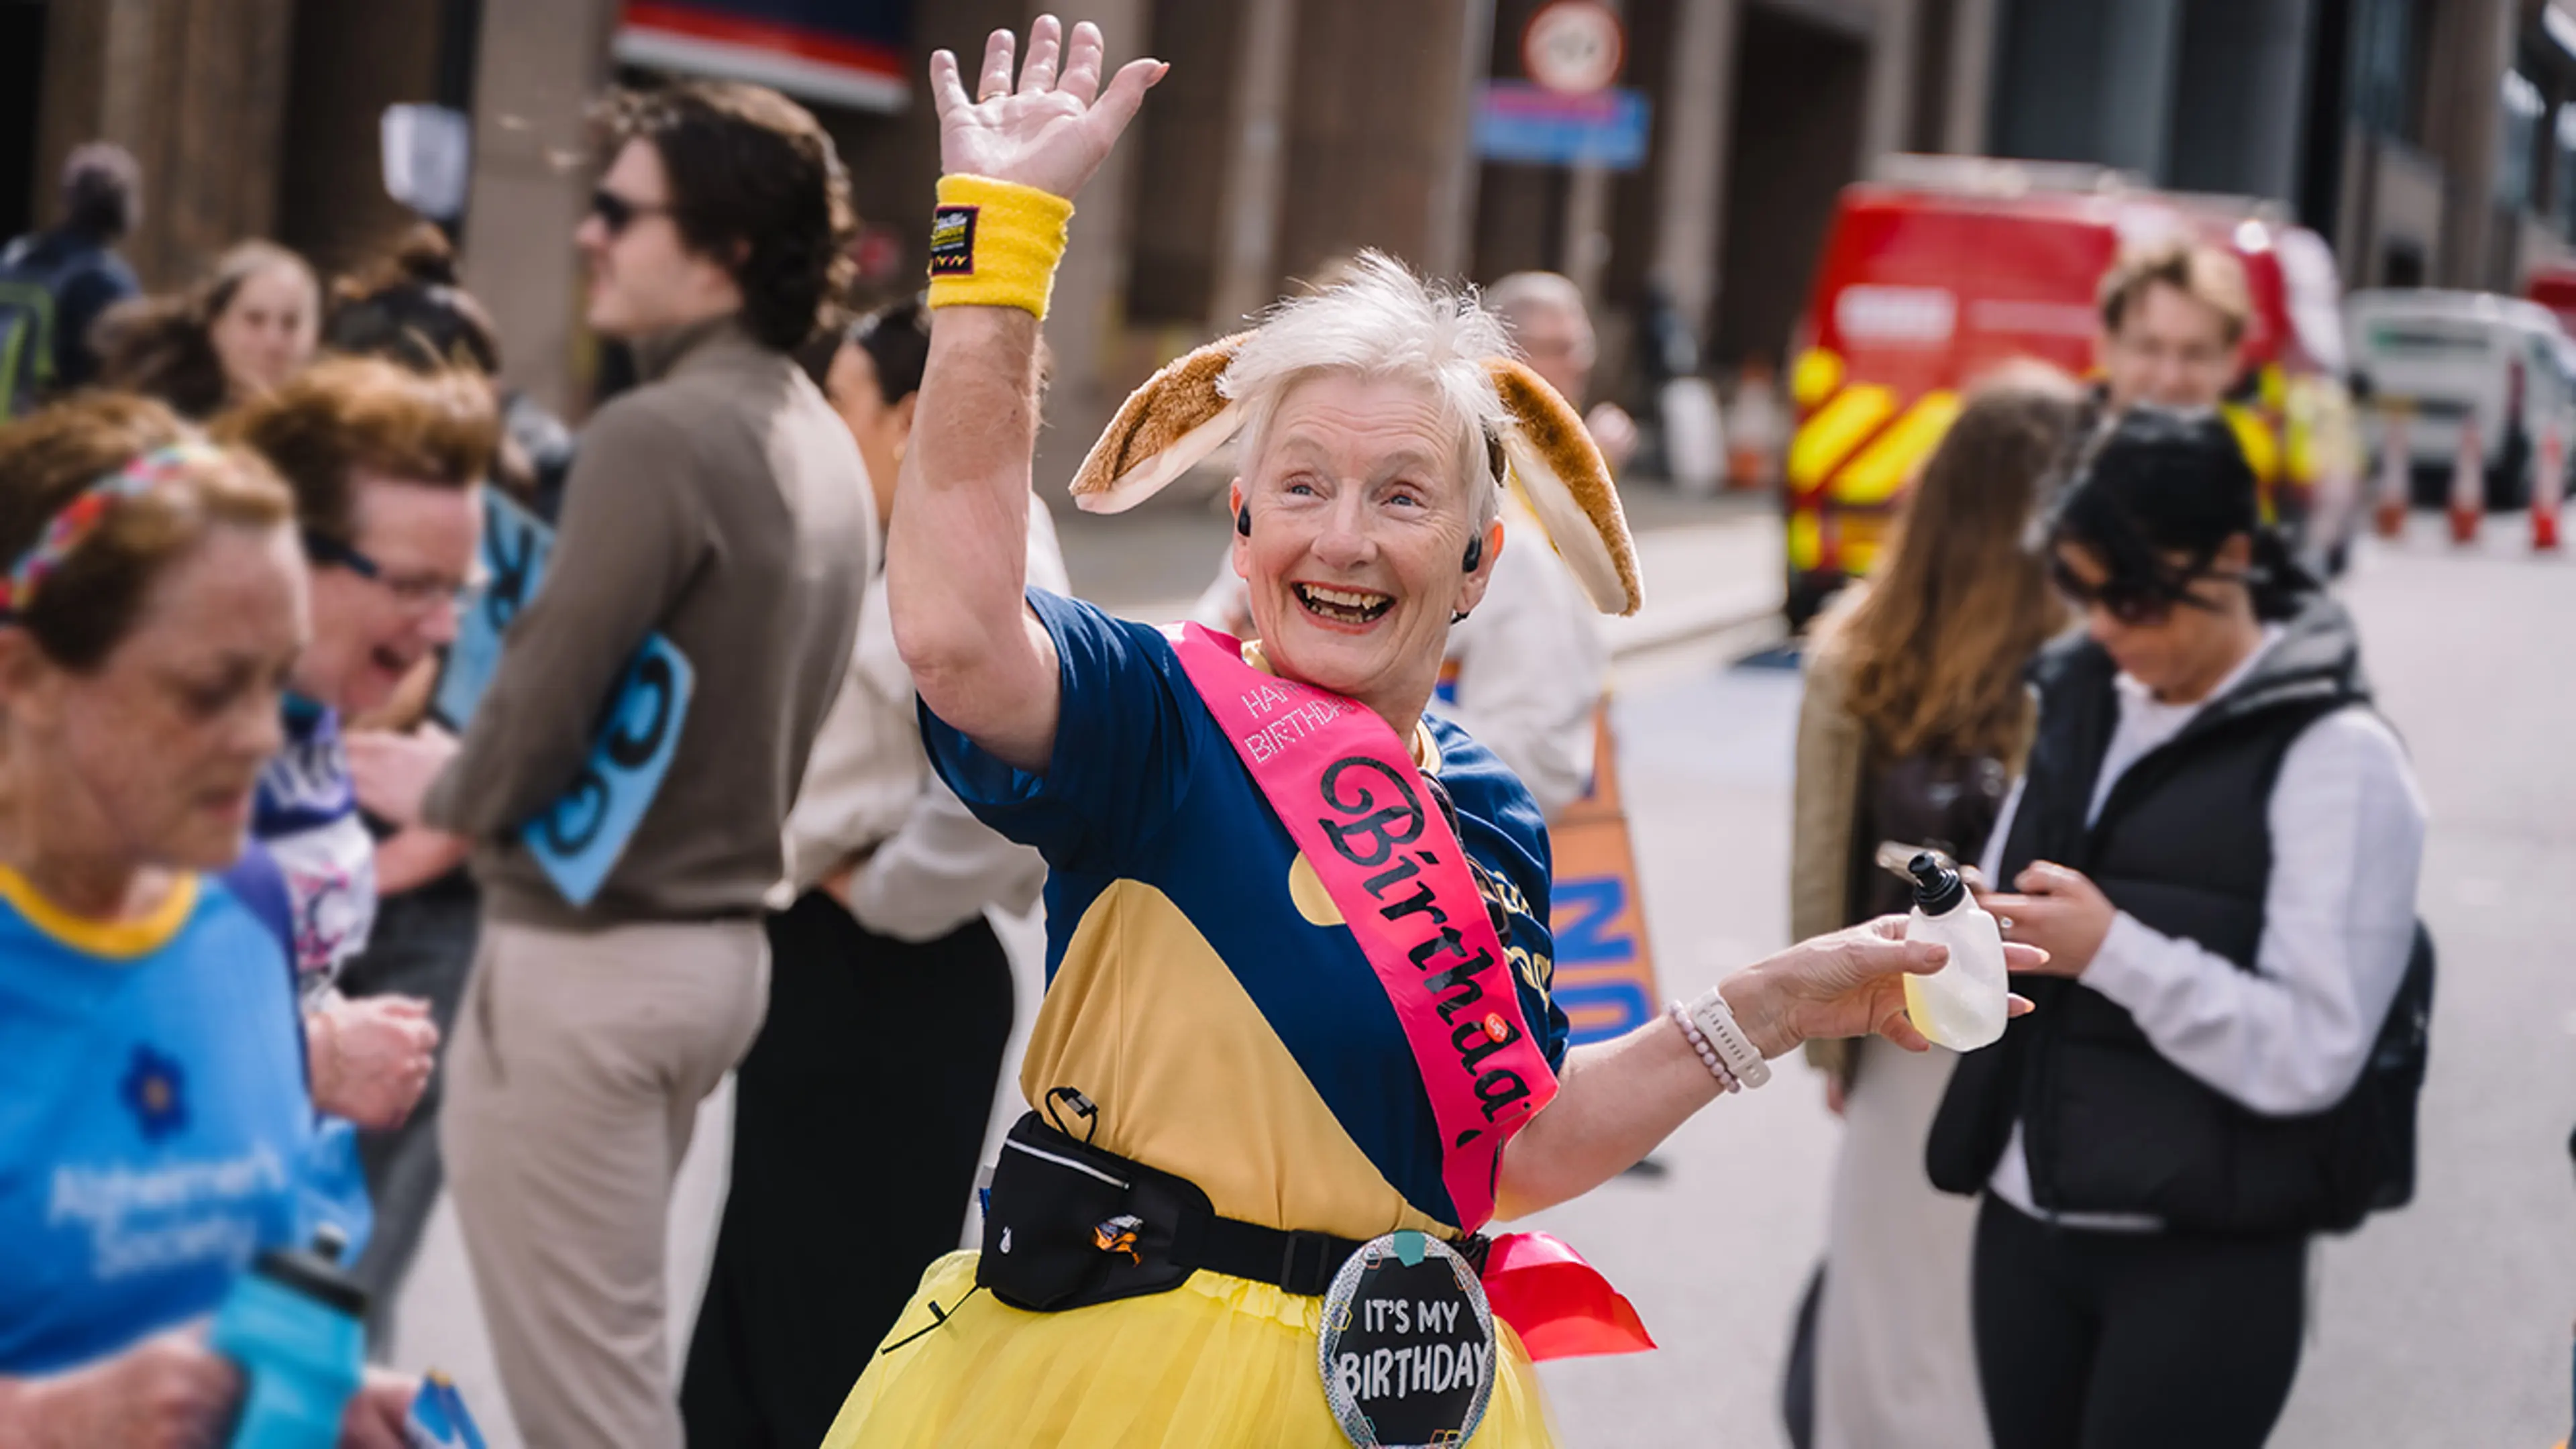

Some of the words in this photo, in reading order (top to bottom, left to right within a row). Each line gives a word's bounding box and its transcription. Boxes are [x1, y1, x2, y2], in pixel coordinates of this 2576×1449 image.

[1241, 681, 1312, 719] HAPP
[1364, 1299, 1411, 1334] IT'S
[1417, 1299, 1460, 1334] MY
[1340, 1340, 1488, 1401] BIRTHDAY
